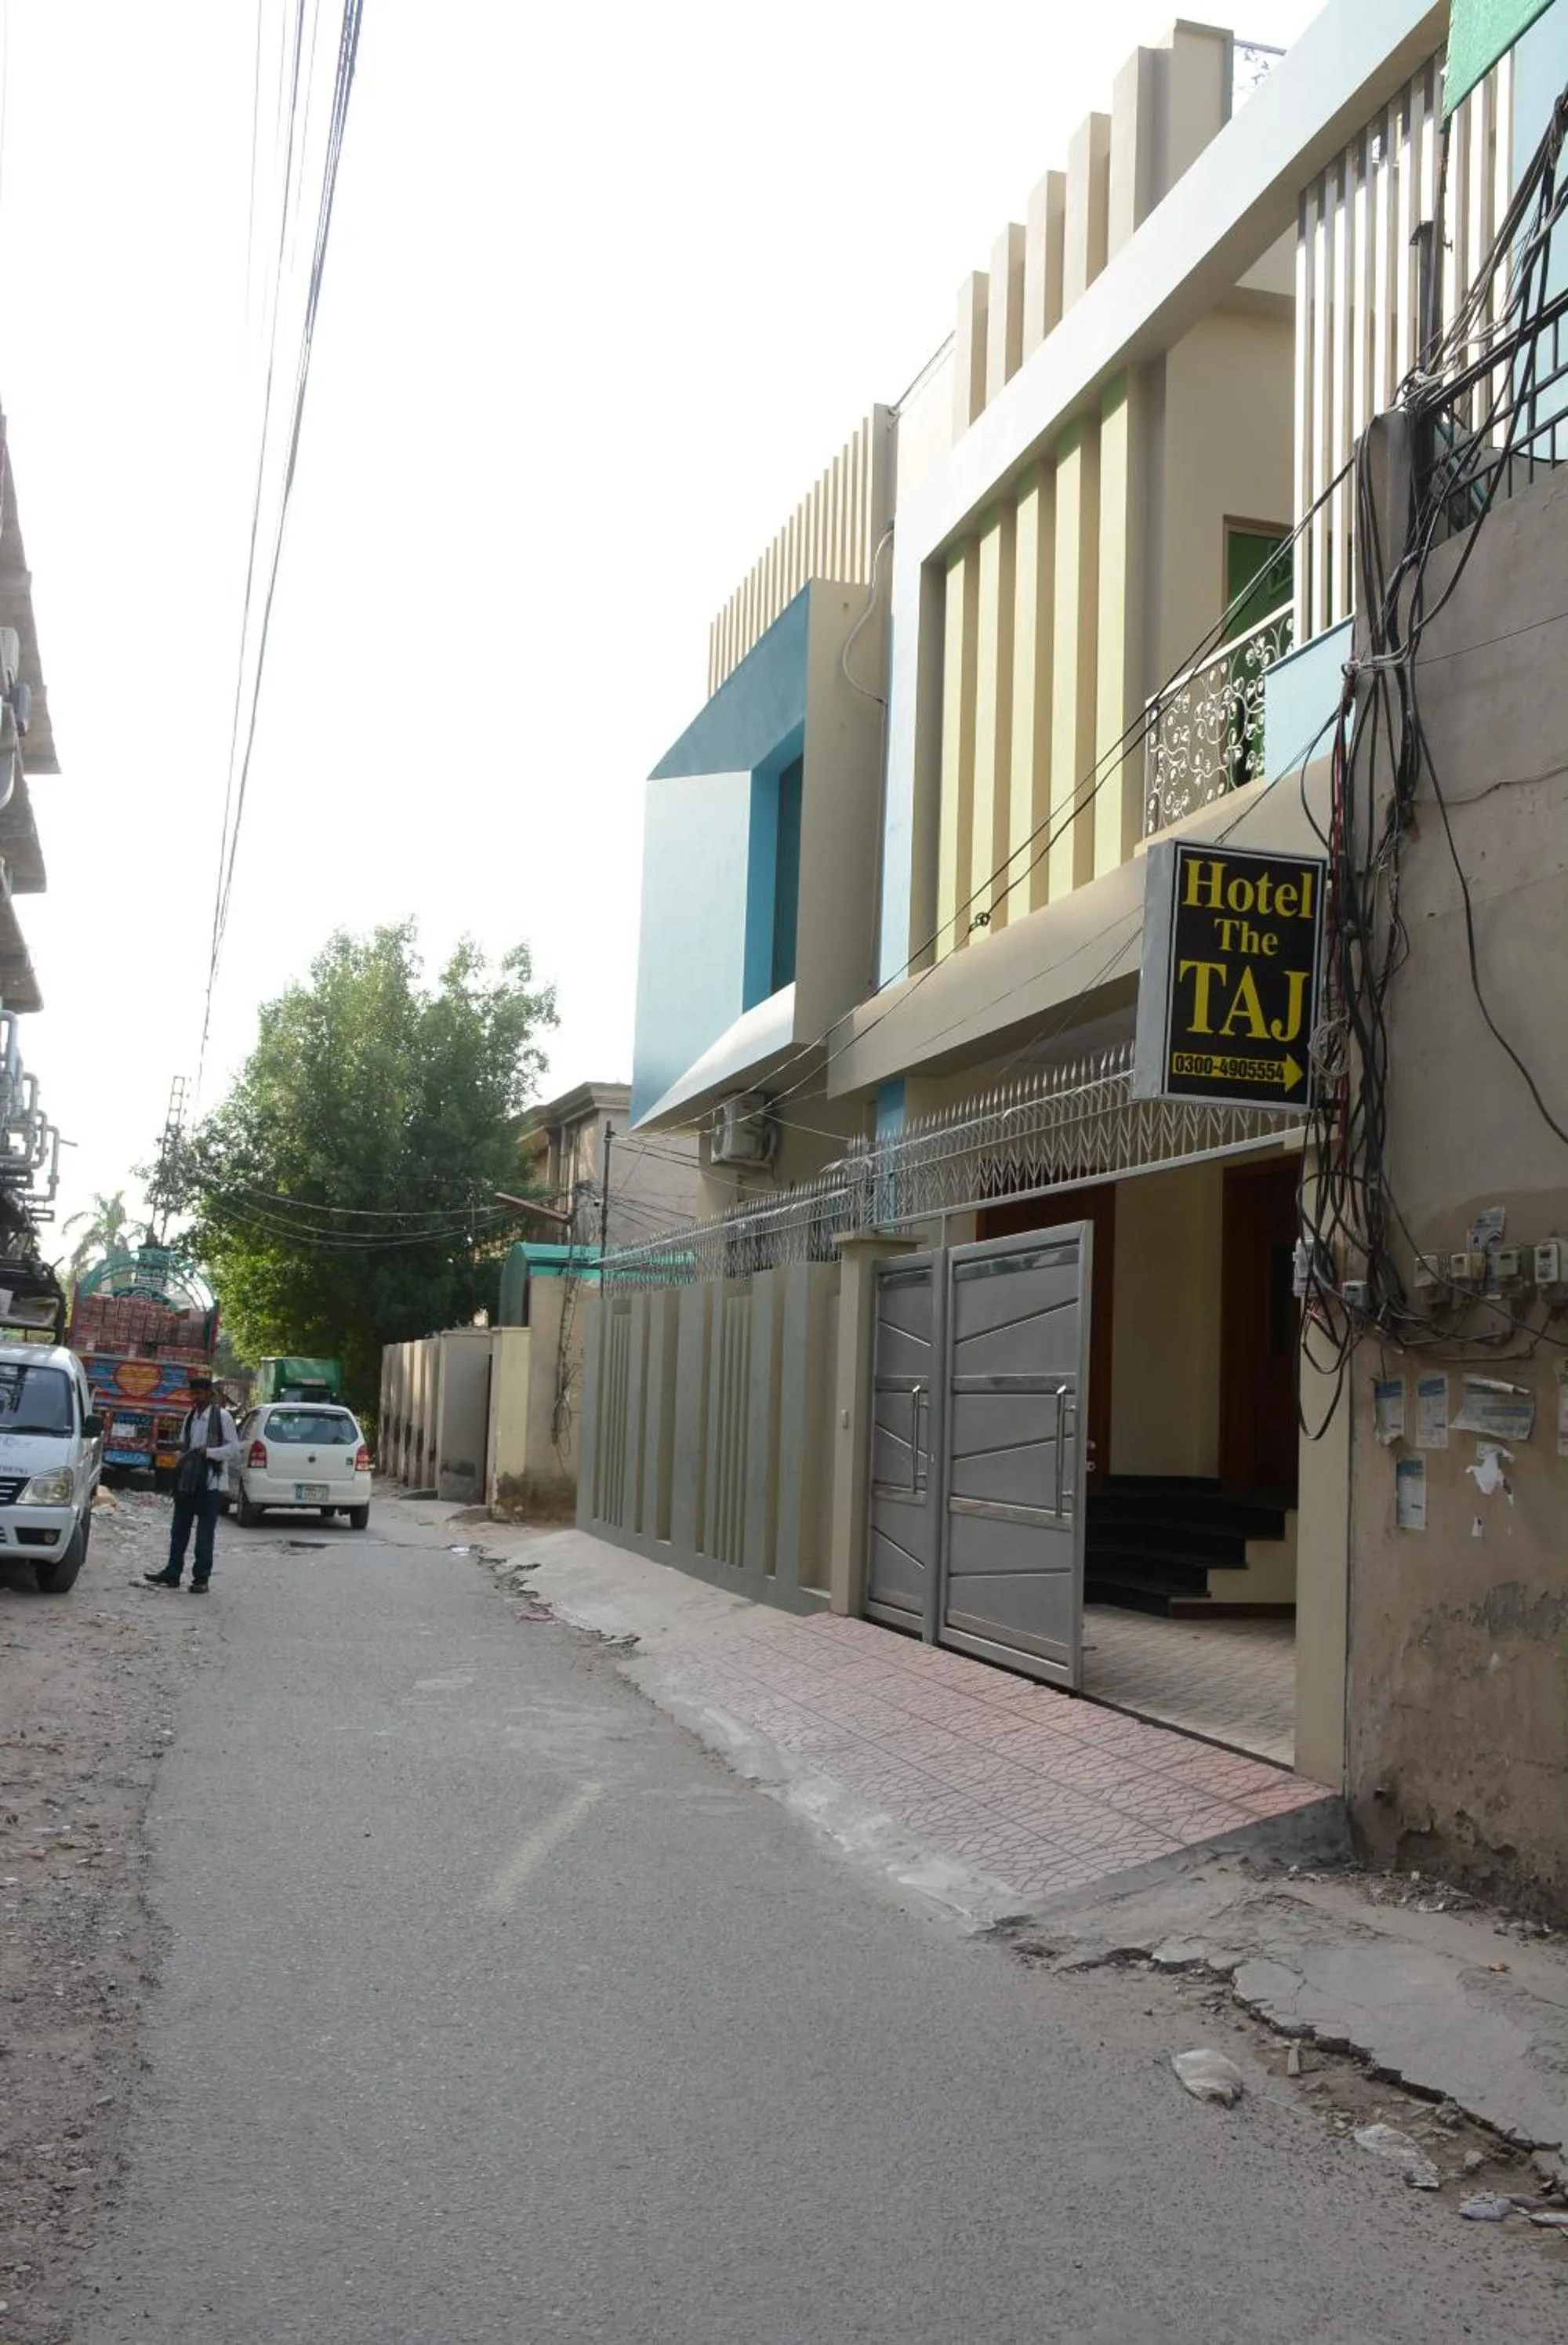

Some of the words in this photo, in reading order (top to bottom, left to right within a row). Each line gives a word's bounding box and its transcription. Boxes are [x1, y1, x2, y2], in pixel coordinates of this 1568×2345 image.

[1181, 859, 1314, 919] Hotel
[1214, 918, 1279, 956] The
[1178, 960, 1310, 1043] TAJ
[1175, 1055, 1284, 1080] 0300-4905554
